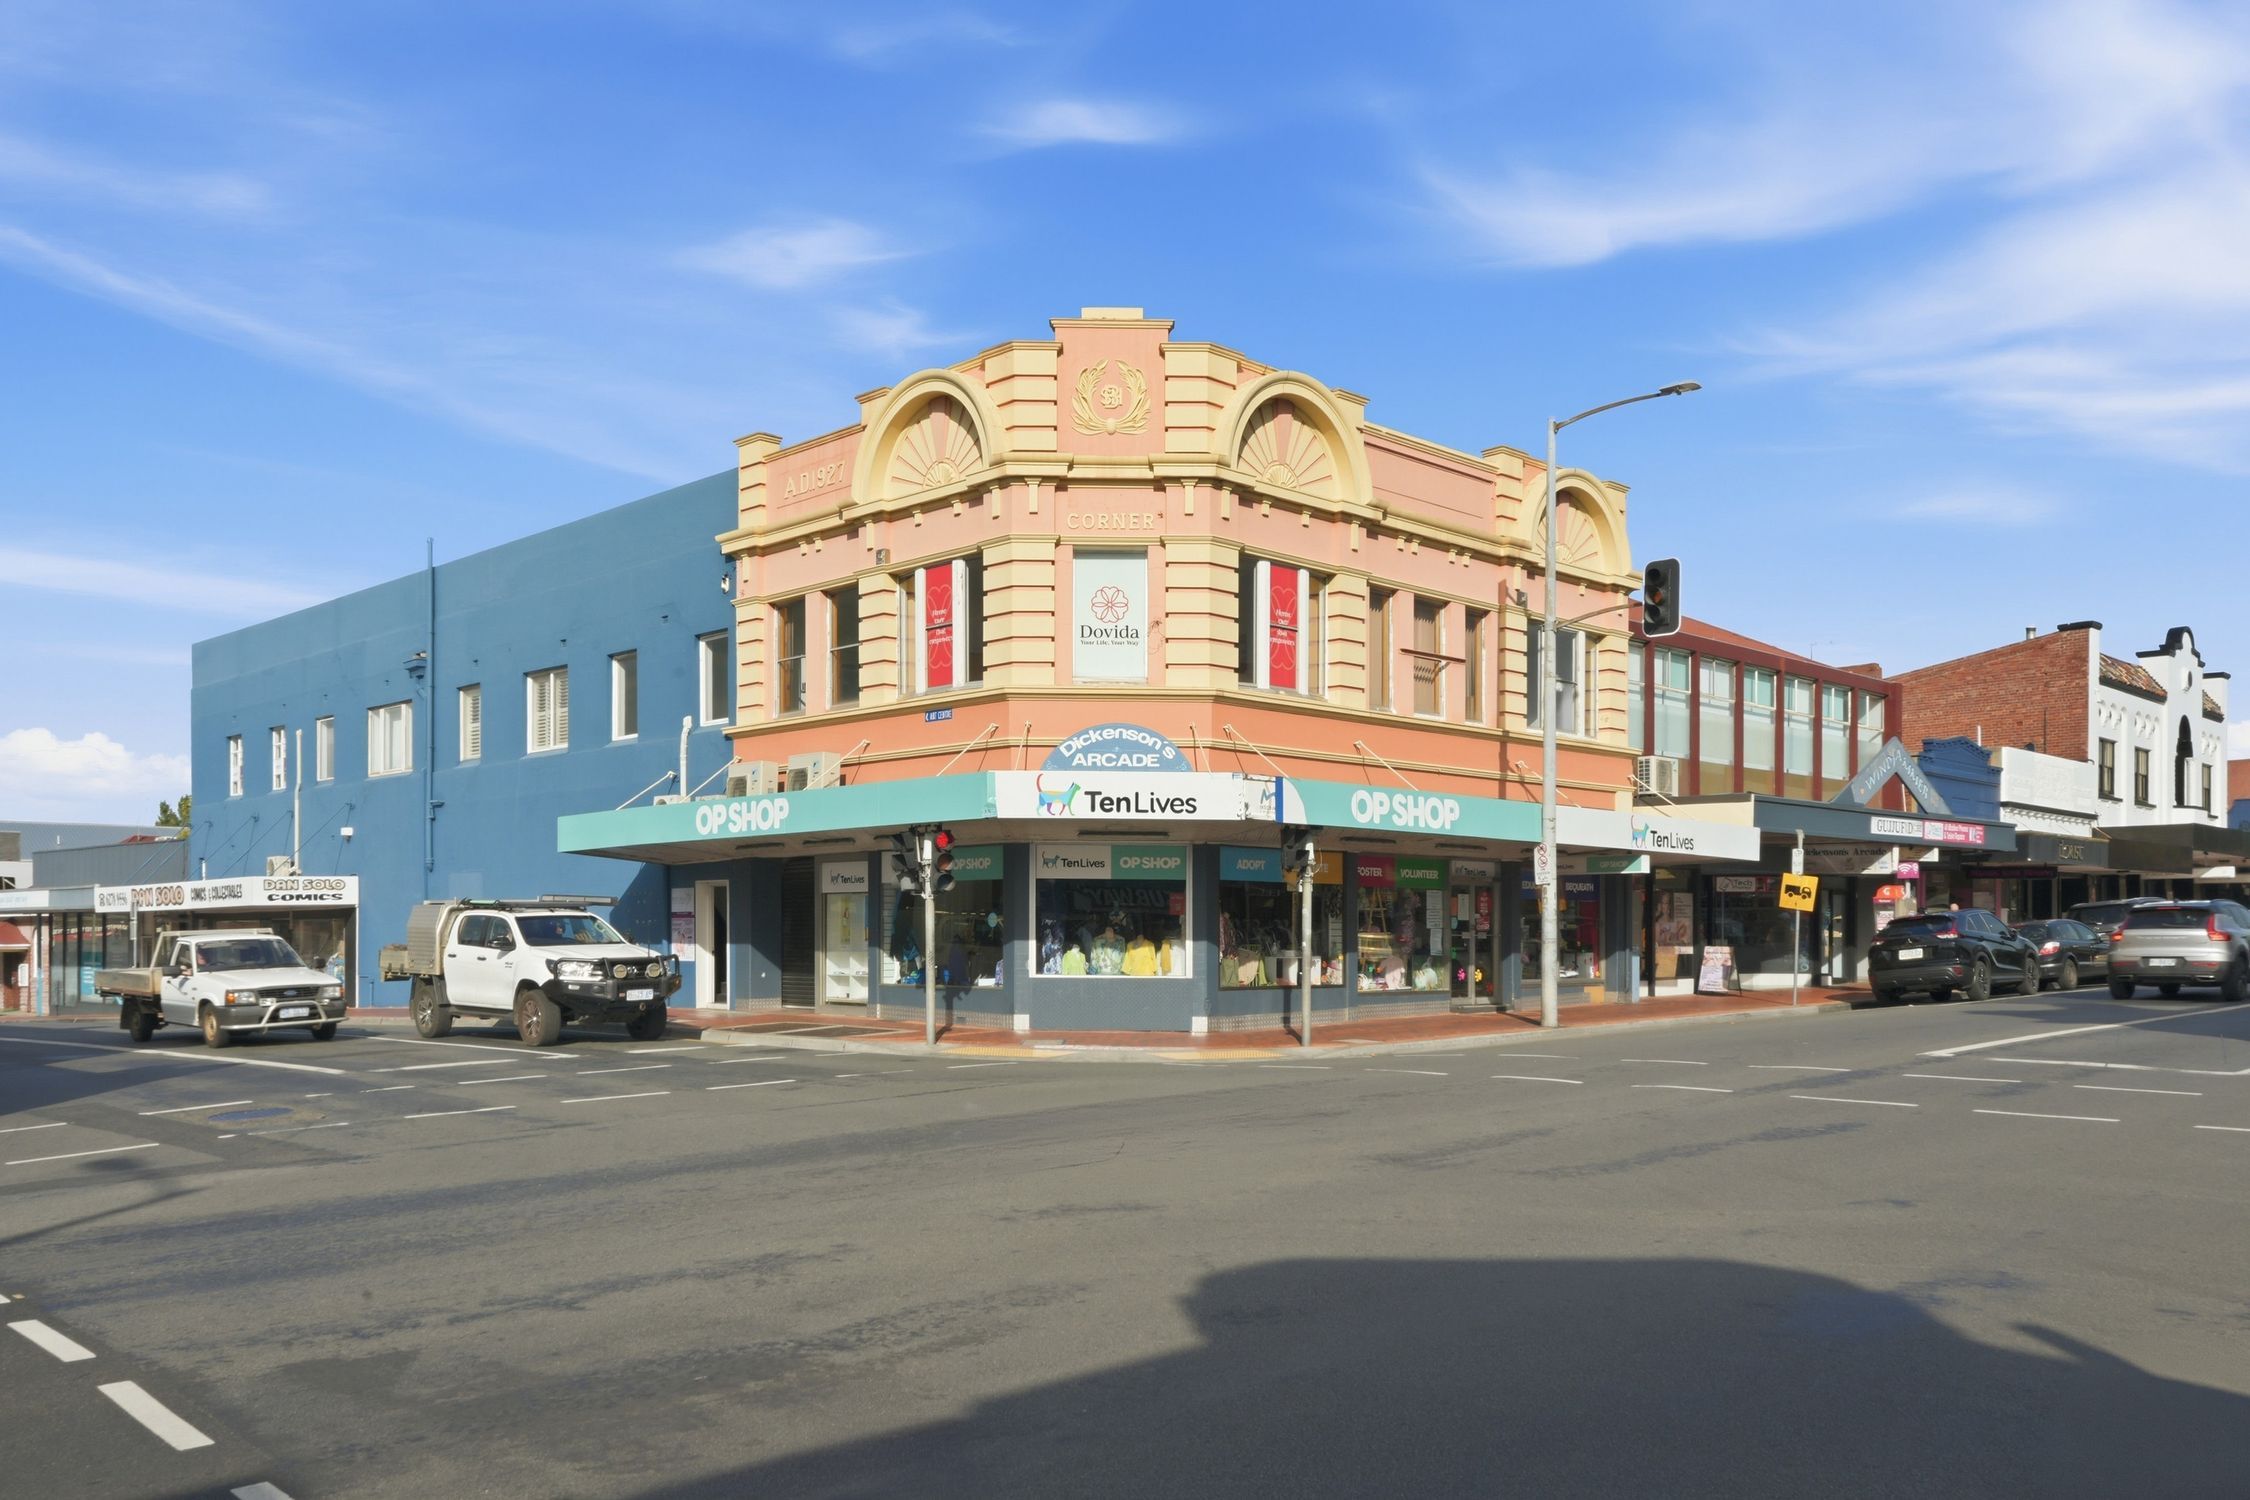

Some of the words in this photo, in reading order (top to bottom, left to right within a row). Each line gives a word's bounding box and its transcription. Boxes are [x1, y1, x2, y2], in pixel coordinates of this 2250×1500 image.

[1067, 512, 1155, 530] CORNER
[1080, 625, 1139, 638] Dovida
[1072, 753, 1160, 767] ARCADE
[1351, 789, 1390, 824] OP
[1392, 793, 1460, 830] SHOP
[695, 804, 727, 835] OP
[728, 798, 789, 833] SHOP
[967, 858, 991, 869] SHOP
[1120, 857, 1140, 868] OP
[1141, 857, 1180, 869] SHOP
[1236, 859, 1265, 870] ADOPT
[1400, 868, 1439, 879] VOLUNTEER
[263, 879, 299, 891] DAN
[302, 879, 345, 891] SOLO
[1565, 881, 1594, 893] BEQUEATH
[131, 888, 153, 908] DAN
[155, 885, 184, 907] SOLO
[267, 893, 343, 901] COMICS
